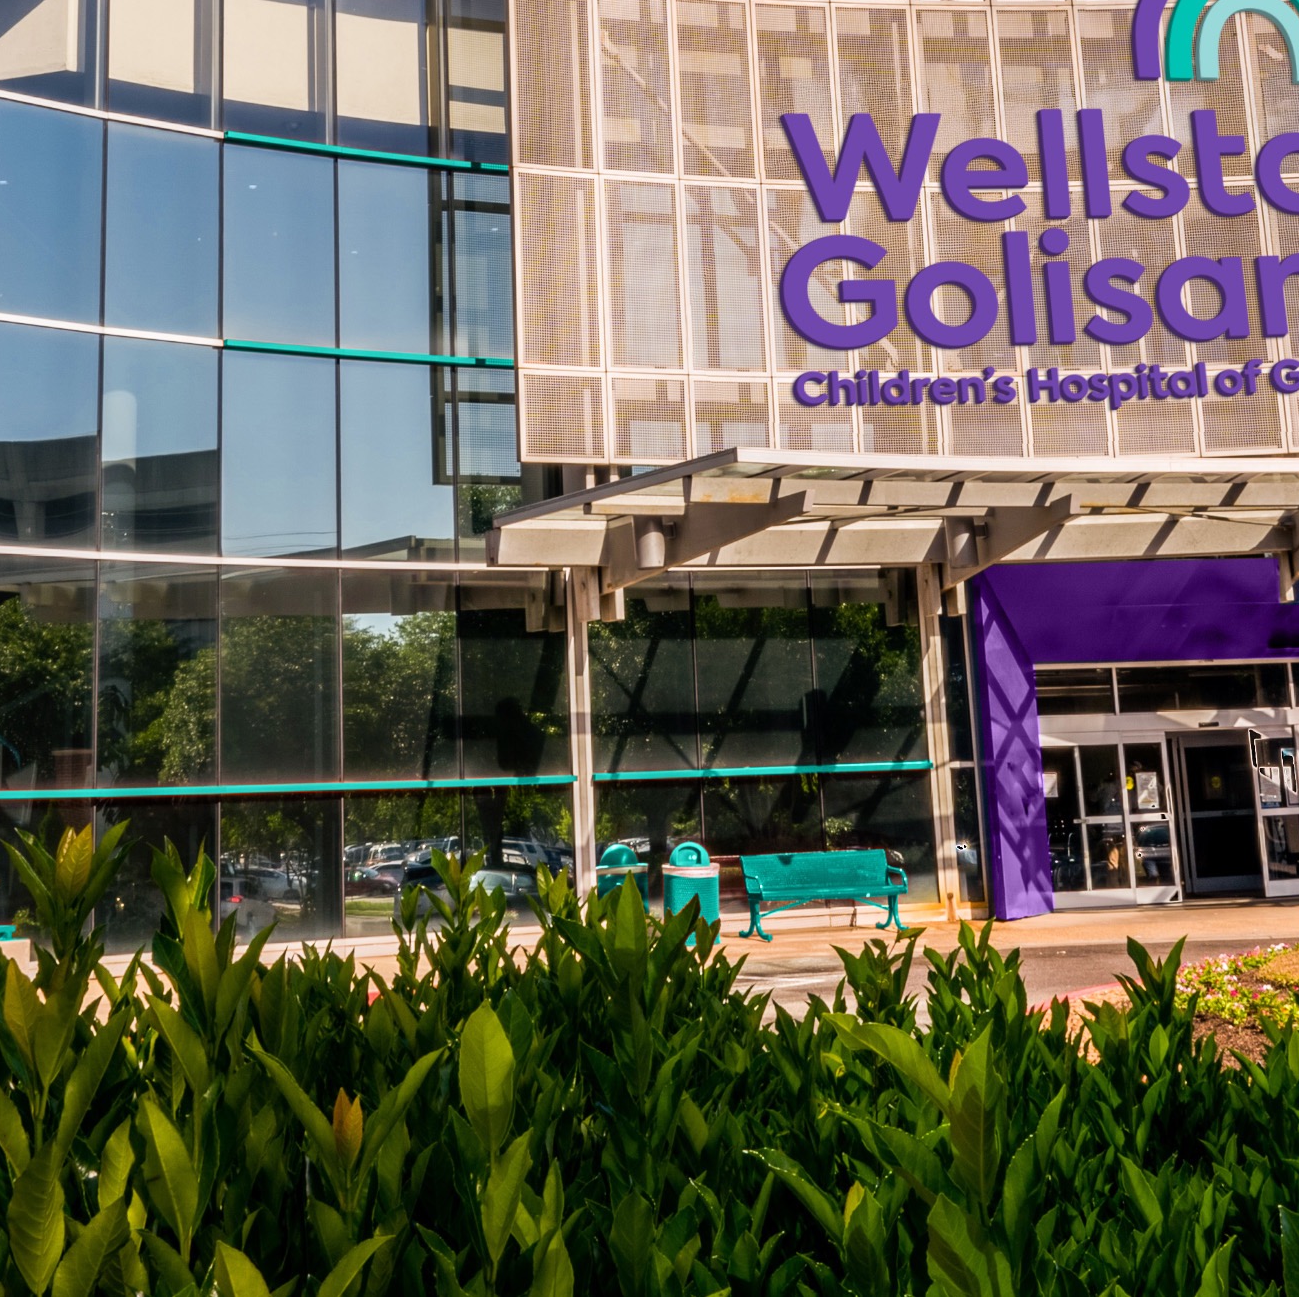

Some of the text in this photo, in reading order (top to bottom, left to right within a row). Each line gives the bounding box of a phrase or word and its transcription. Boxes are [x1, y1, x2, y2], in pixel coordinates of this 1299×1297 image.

[792, 366, 1017, 407] Children's
[1026, 362, 1209, 411] Hospital
[1214, 358, 1264, 397] of
